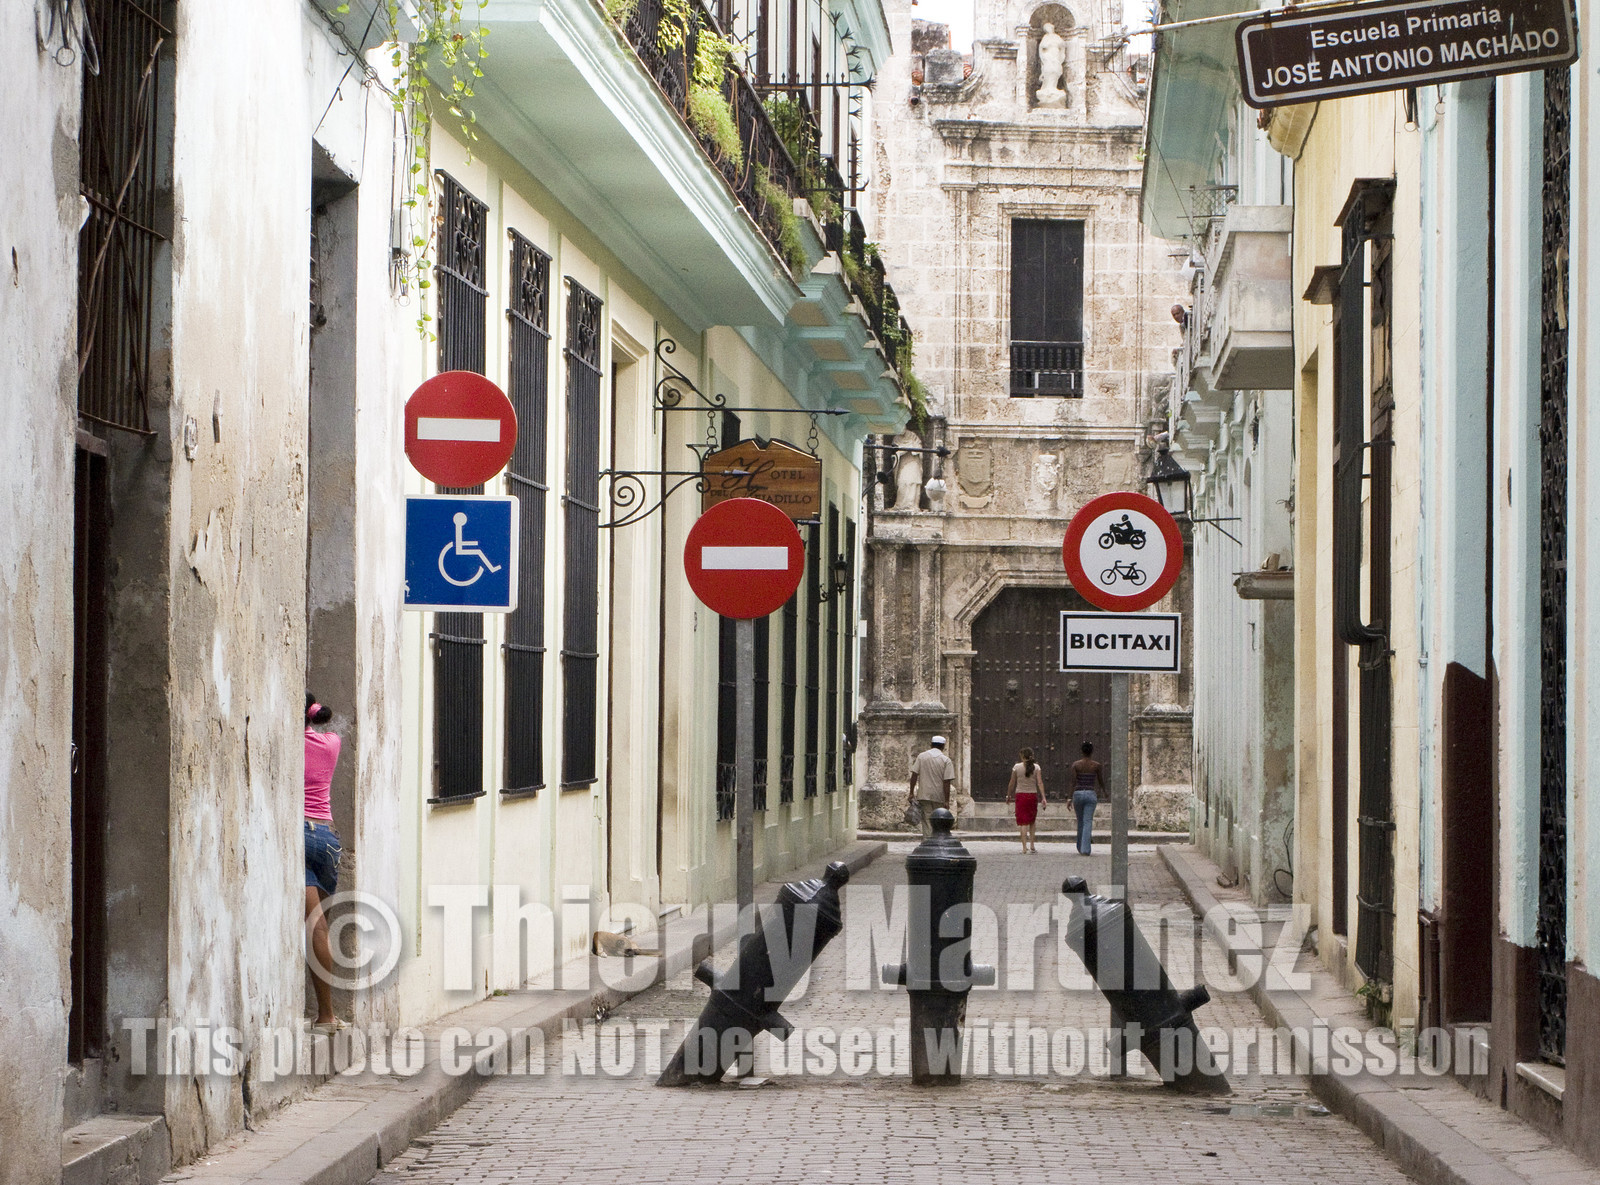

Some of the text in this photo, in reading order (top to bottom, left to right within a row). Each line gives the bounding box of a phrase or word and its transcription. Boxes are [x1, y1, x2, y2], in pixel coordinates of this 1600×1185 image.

[1311, 6, 1501, 49] Escuela Primaria
[1328, 47, 1434, 80] ANTONIO
[1440, 28, 1560, 63] MACHADO
[1070, 633, 1171, 651] BICITAXI
